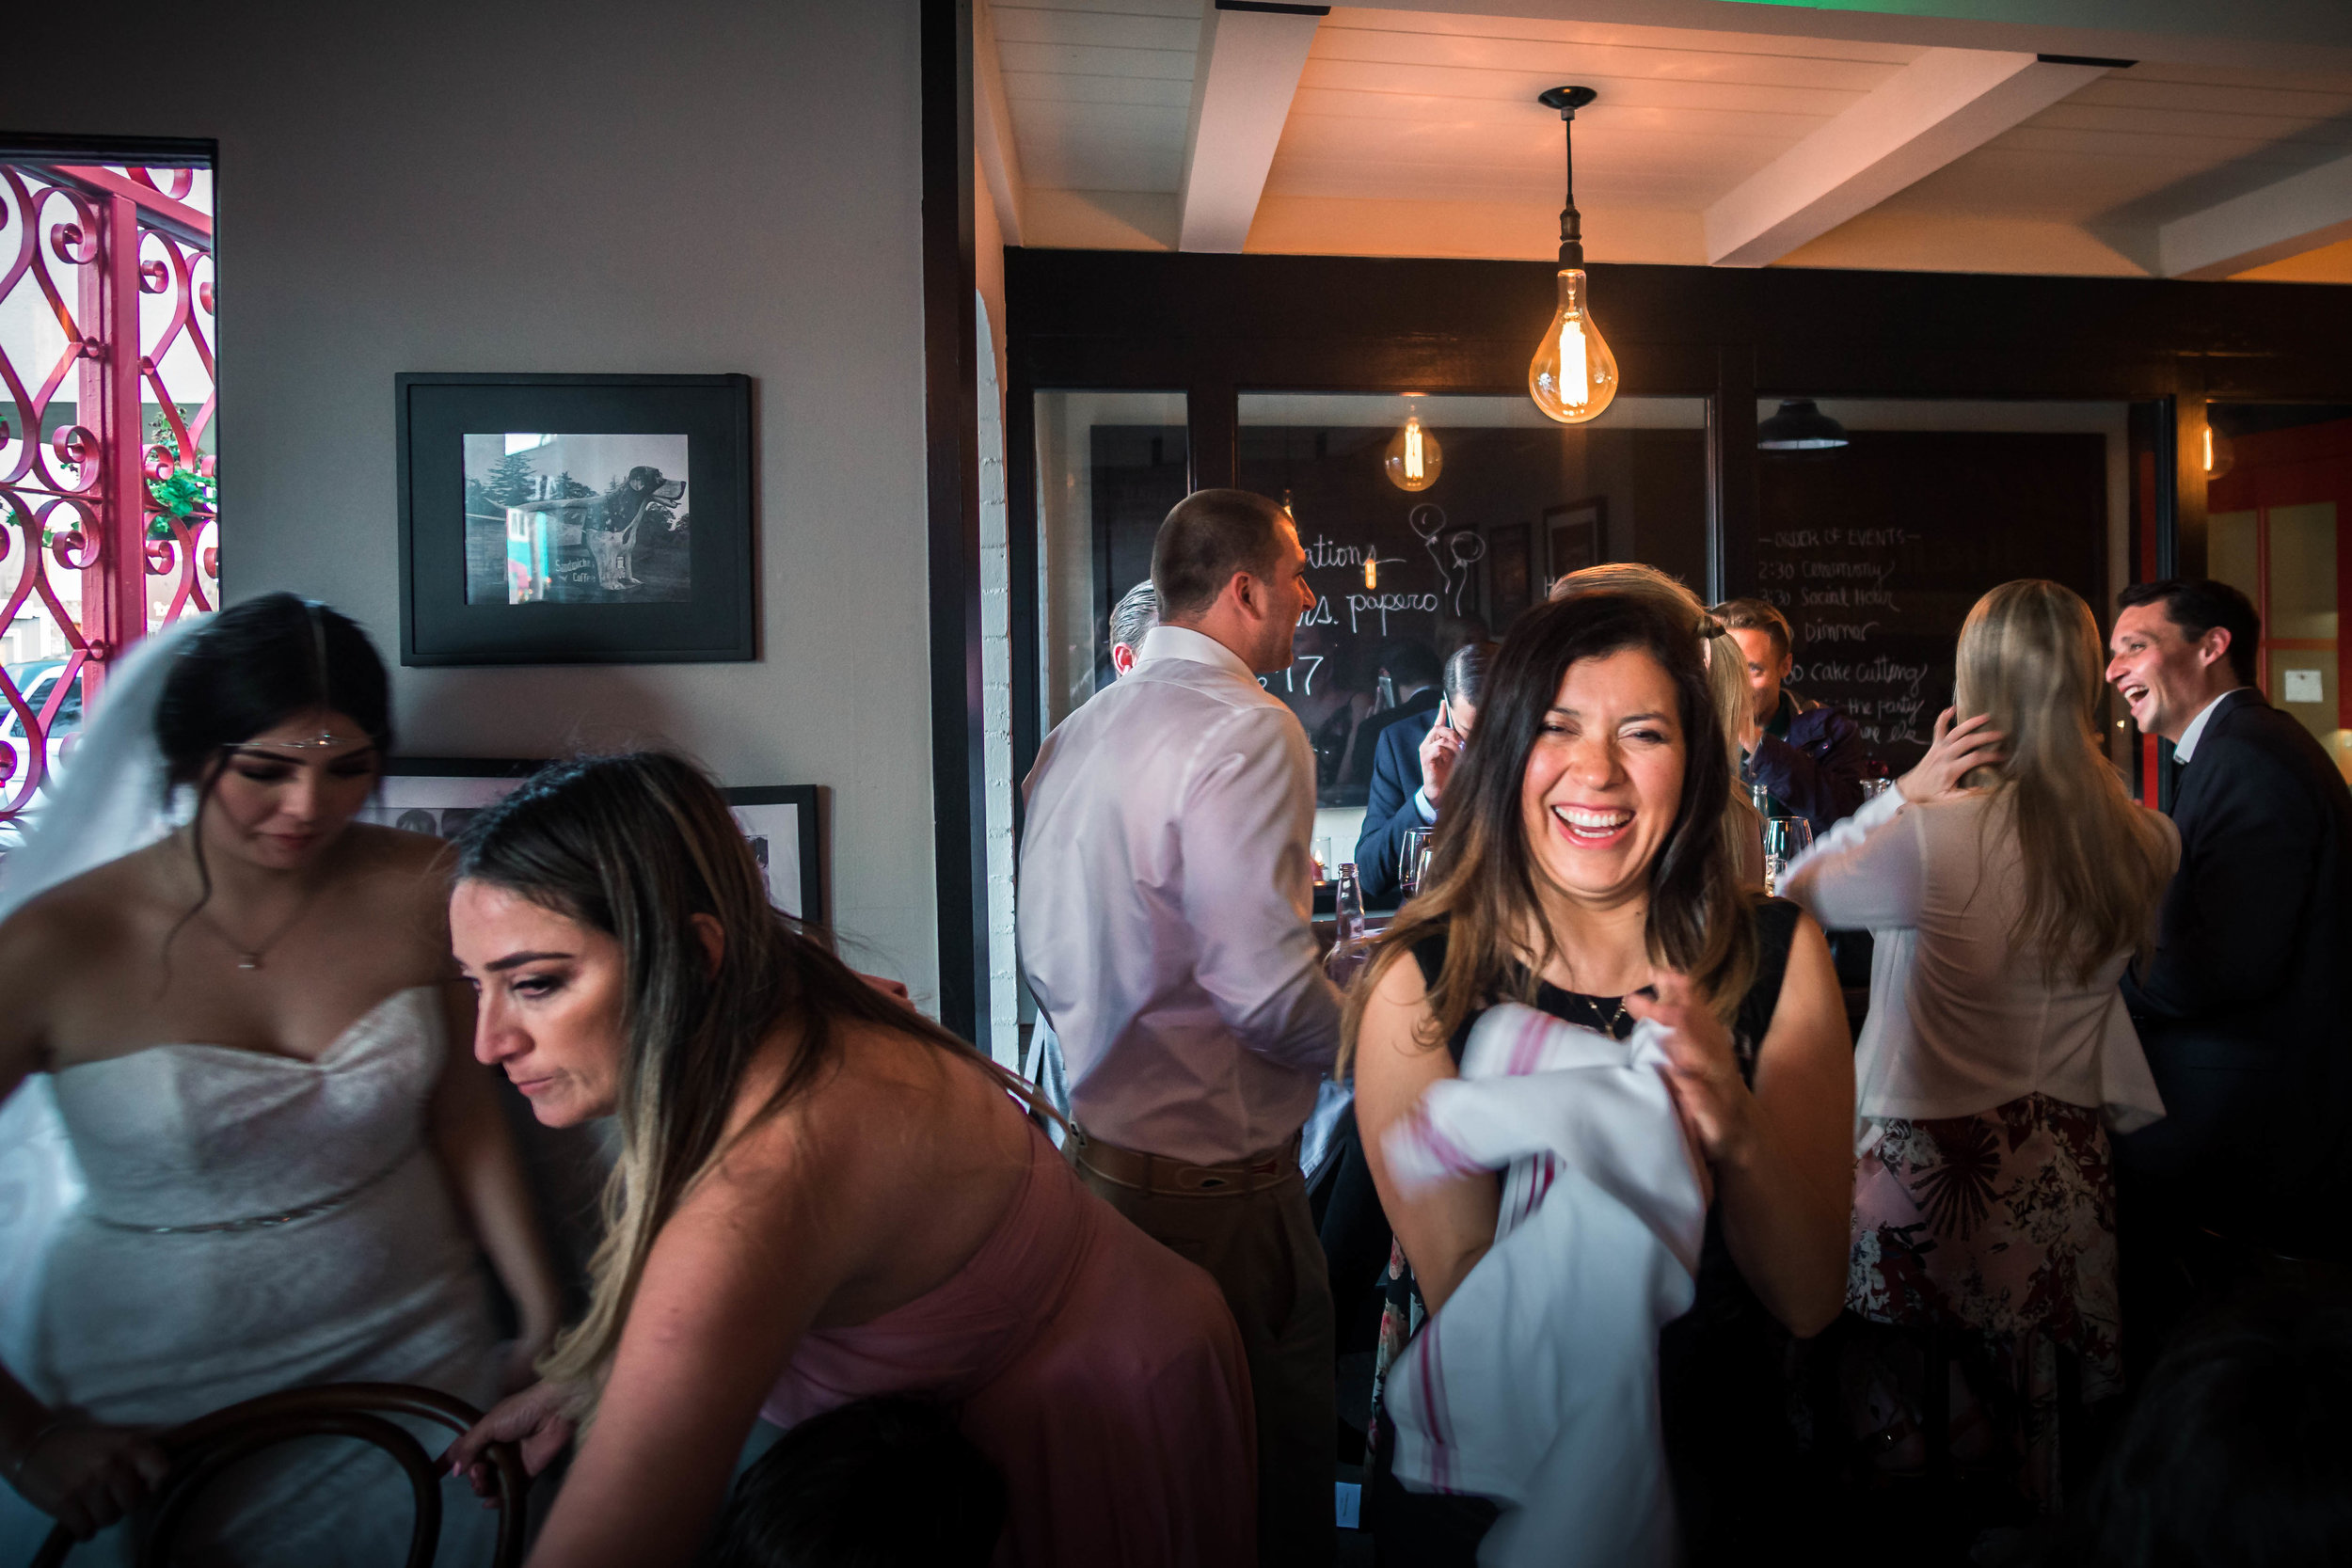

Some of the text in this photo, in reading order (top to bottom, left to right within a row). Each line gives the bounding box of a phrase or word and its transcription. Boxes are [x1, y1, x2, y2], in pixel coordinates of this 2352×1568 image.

[1848, 527, 1905, 546] EVENTS
[1758, 561, 1794, 579] 2:30
[1800, 585, 1850, 608] Social
